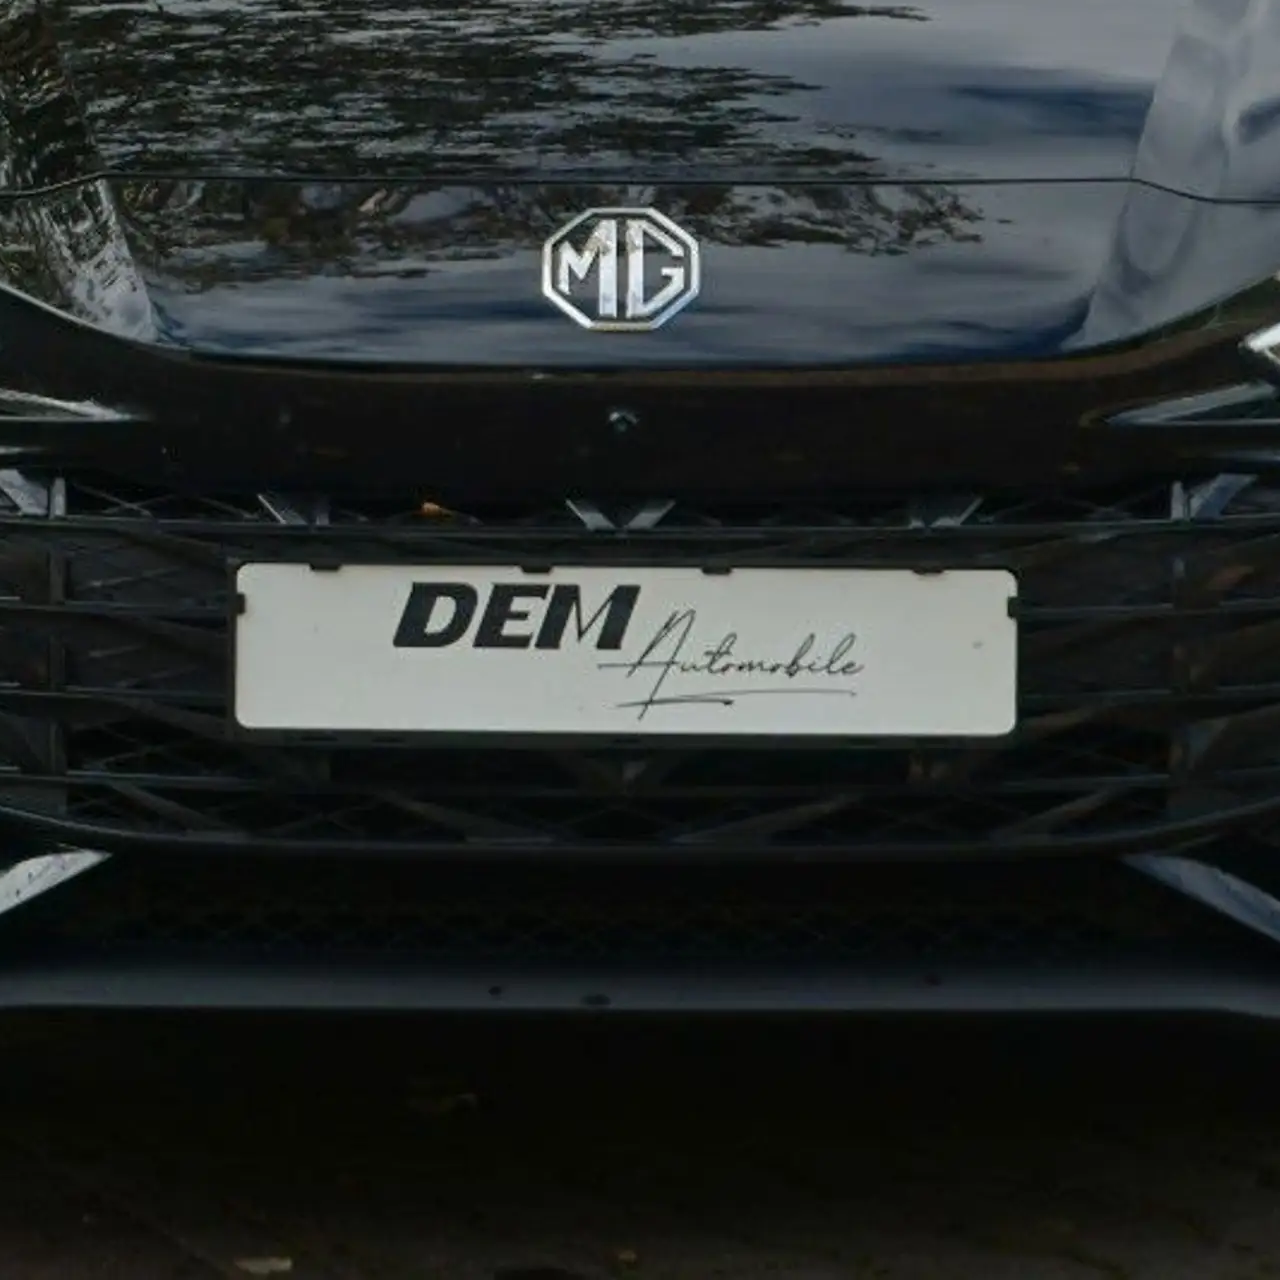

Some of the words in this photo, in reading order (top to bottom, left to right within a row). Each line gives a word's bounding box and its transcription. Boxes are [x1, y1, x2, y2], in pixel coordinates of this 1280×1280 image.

[558, 218, 686, 319] MG
[392, 582, 642, 651] DEM
[597, 608, 866, 721] Automobile
